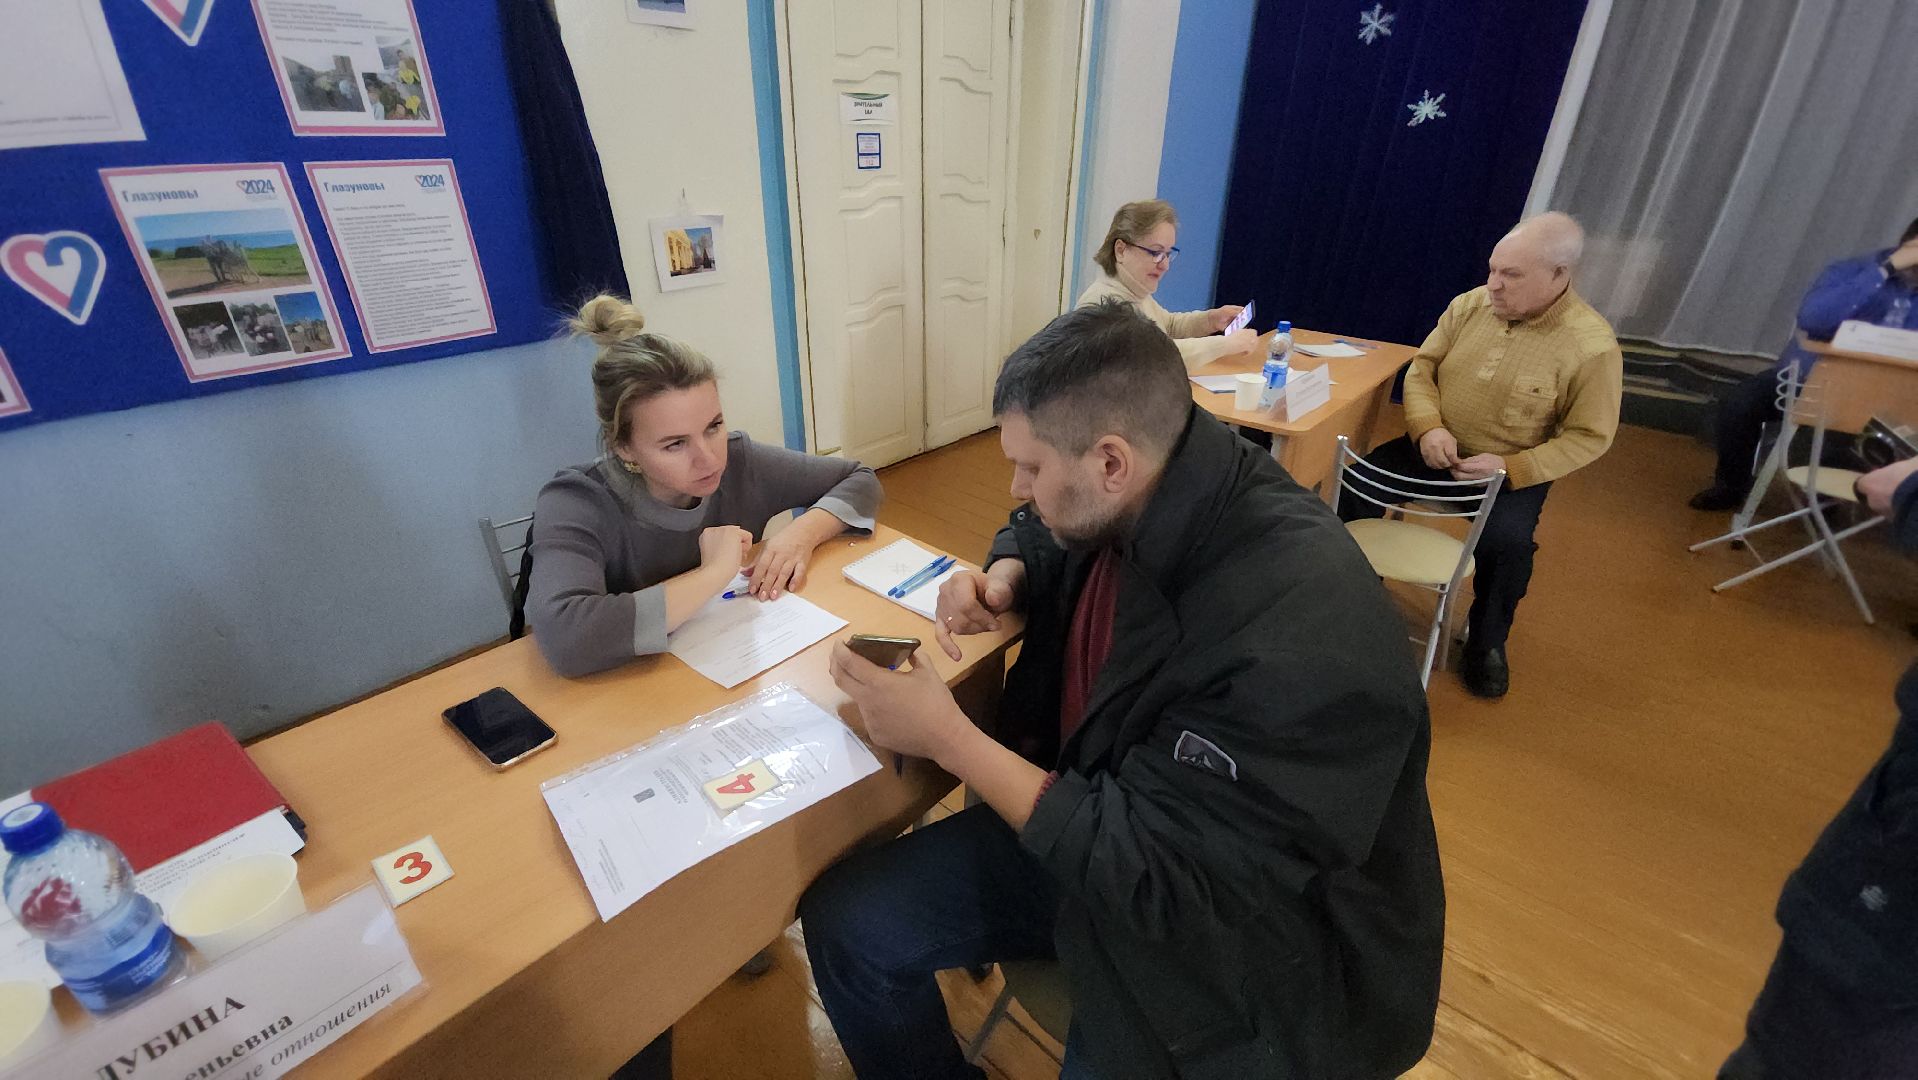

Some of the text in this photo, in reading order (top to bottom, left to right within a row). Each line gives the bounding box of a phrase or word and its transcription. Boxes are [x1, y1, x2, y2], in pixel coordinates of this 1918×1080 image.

[242, 179, 276, 194] 2024
[323, 181, 385, 193] Глазуновы
[419, 174, 446, 188] 2024
[121, 189, 199, 203] Глазуновы
[716, 773, 755, 793] 4
[394, 852, 432, 884] 3
[271, 983, 392, 1066] отношения
